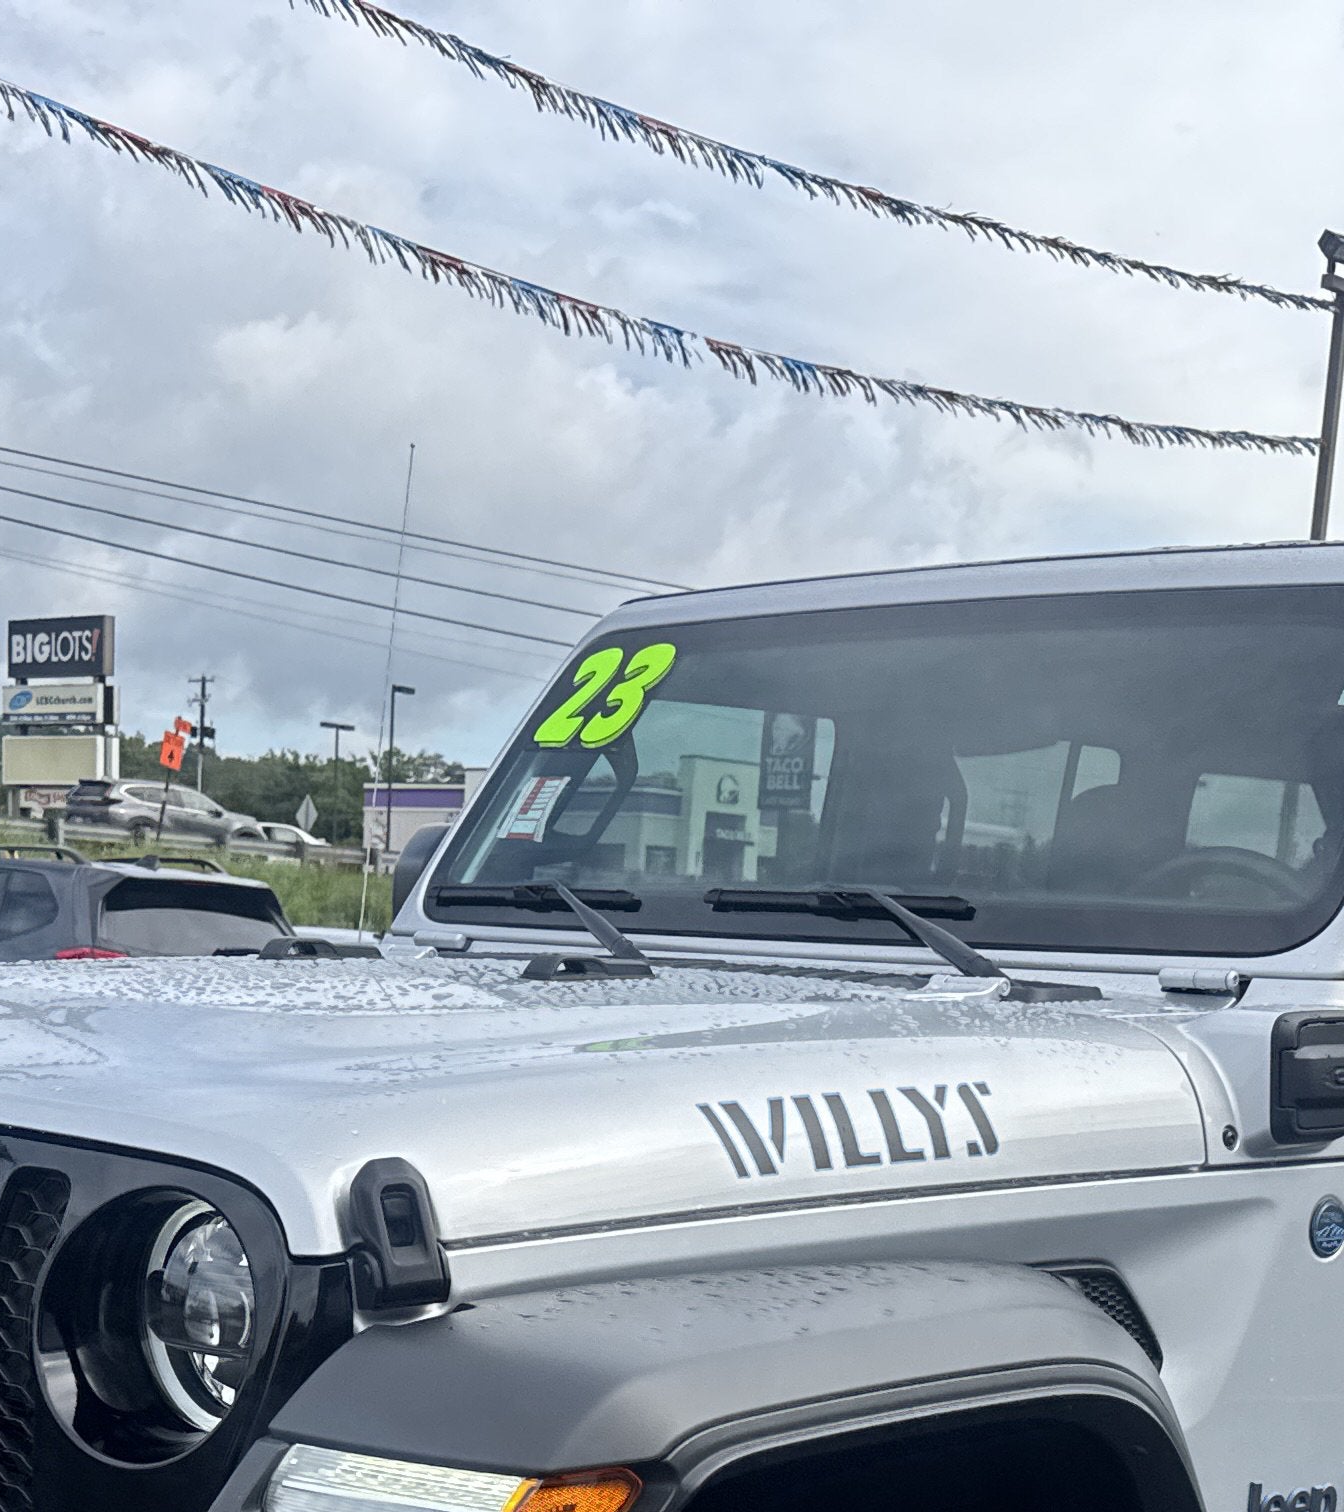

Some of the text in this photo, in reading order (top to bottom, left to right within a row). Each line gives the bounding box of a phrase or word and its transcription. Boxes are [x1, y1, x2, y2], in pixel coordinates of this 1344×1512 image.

[534, 643, 676, 748] 23
[766, 757, 804, 774] TACO
[766, 774, 801, 790] BELL
[696, 1080, 999, 1179] WILLYS
